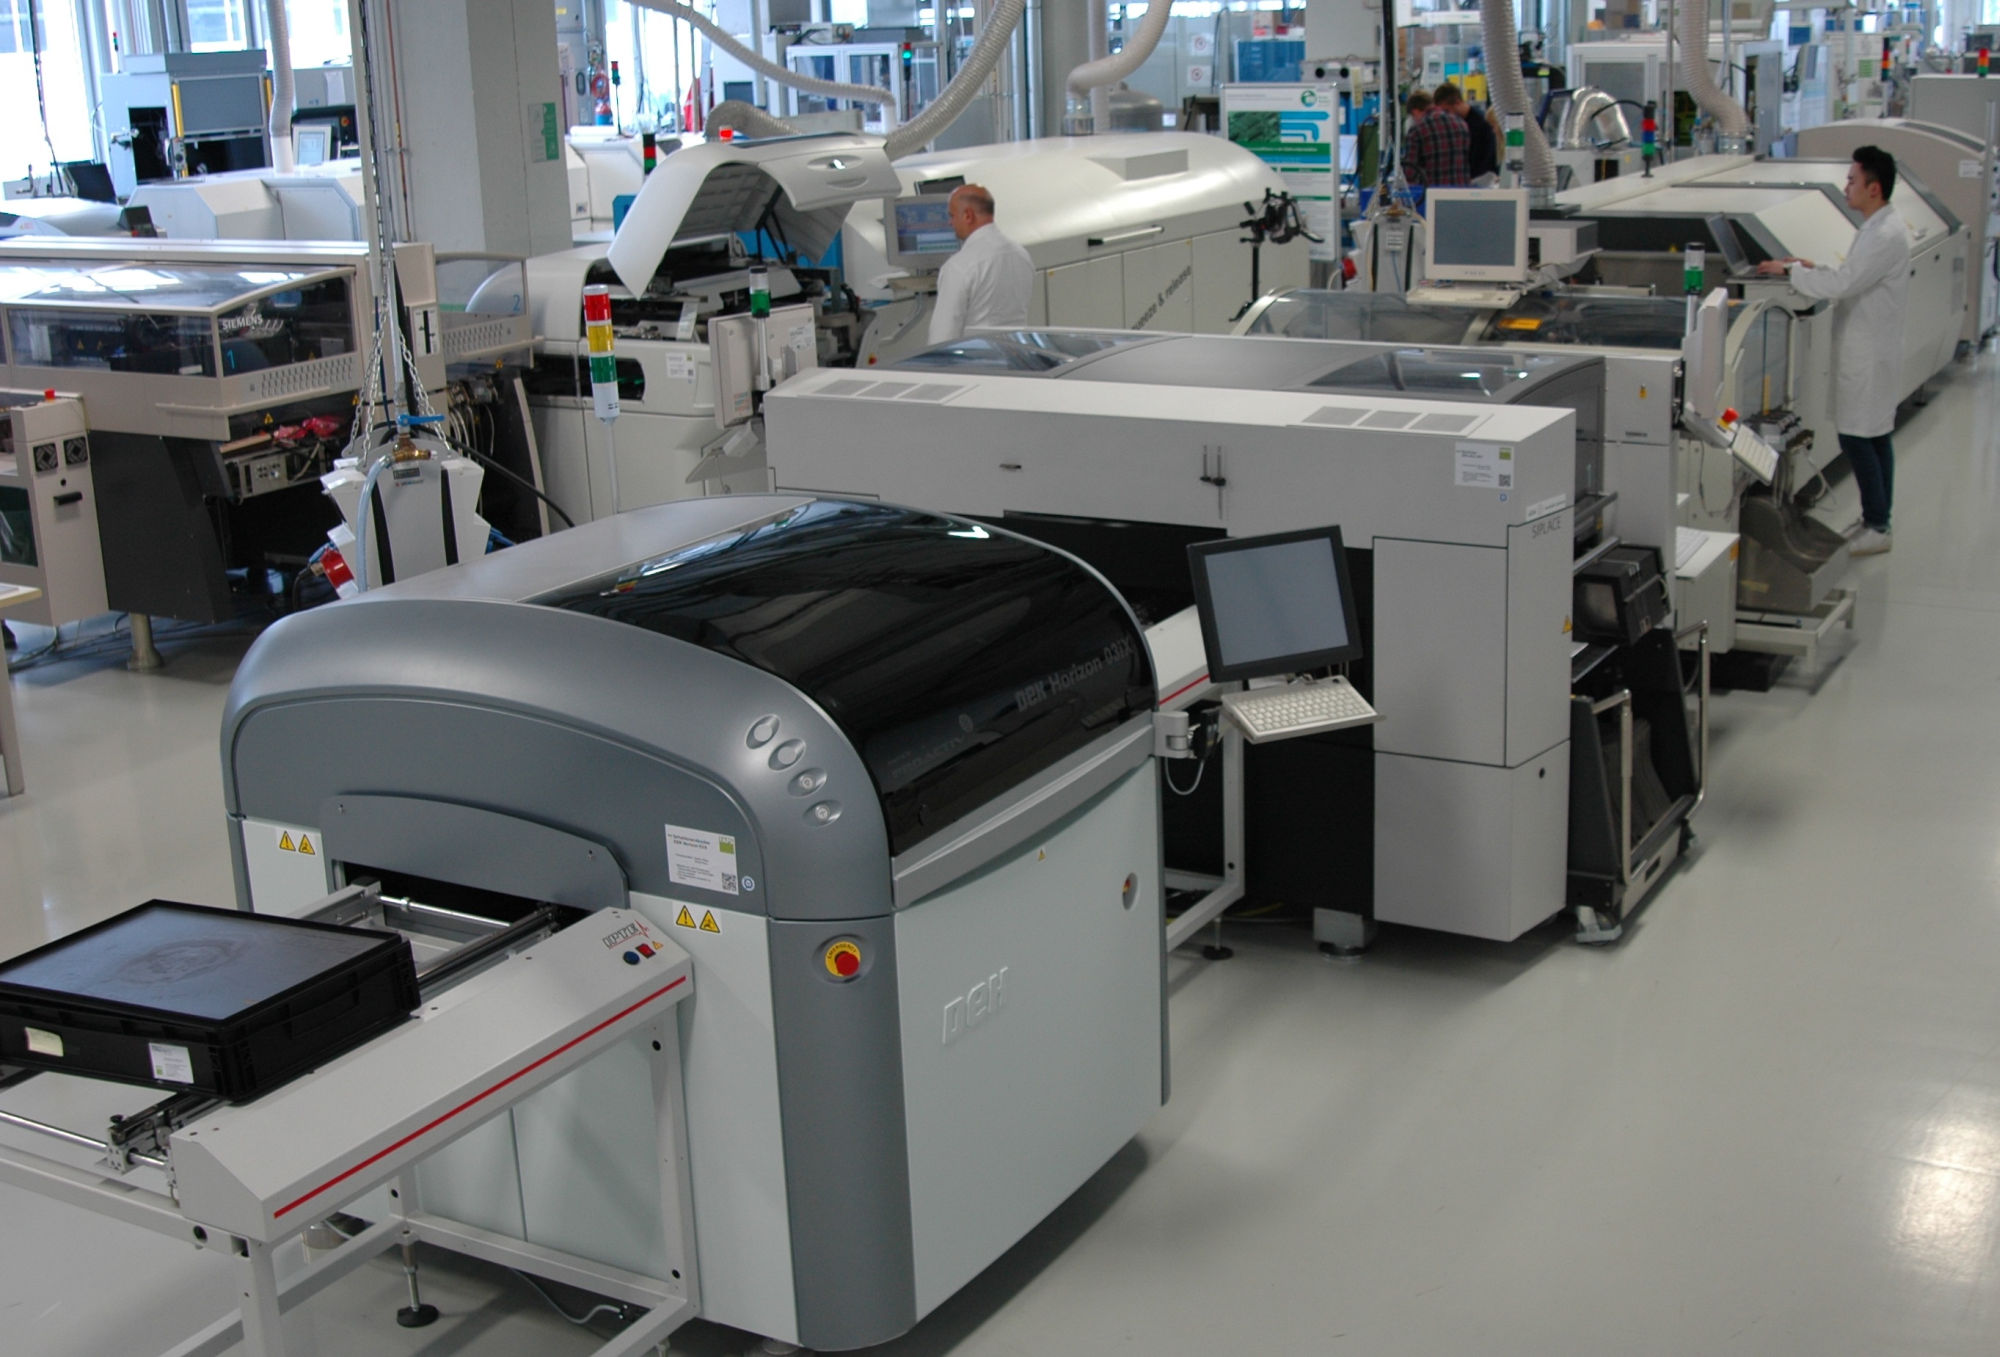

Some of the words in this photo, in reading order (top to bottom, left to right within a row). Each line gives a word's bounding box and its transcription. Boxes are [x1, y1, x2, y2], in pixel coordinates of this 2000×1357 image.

[1158, 292, 1165, 307] &
[1165, 265, 1191, 298] release
[221, 313, 264, 331] SIEMENS
[227, 349, 236, 369] 1
[1048, 658, 1103, 696] Horizon
